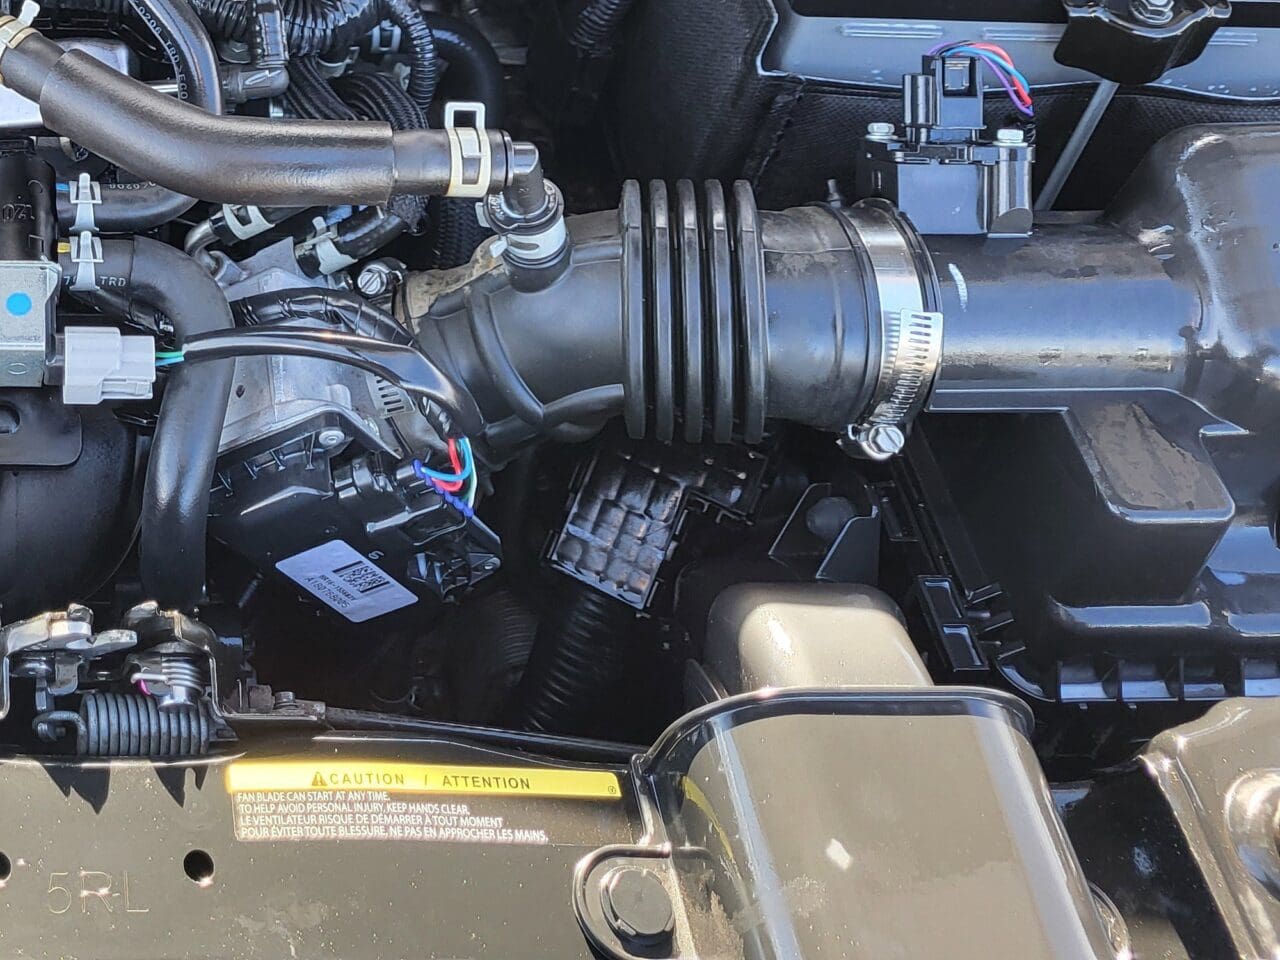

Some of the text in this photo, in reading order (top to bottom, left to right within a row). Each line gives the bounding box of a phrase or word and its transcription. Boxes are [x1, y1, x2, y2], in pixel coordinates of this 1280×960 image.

[99, 276, 127, 287] TRD
[329, 773, 404, 785] CAUTION
[442, 775, 530, 790] ATTENTION
[237, 792, 254, 802] FAN
[257, 792, 285, 801] BLADE
[286, 792, 306, 801] CAN
[307, 792, 334, 801] START
[335, 792, 346, 801] AT
[348, 792, 365, 801] ANY
[239, 803, 252, 814] TO
[254, 803, 275, 814] HELP
[278, 803, 305, 813] AVOID
[307, 803, 352, 813] PERSONAL
[387, 803, 407, 813] KEEP
[409, 804, 439, 814] HANDS
[241, 815, 251, 826] LE
[253, 815, 316, 825] VENTILATEUR
[319, 815, 353, 825] RISQUE
[355, 815, 369, 824] DE
[371, 813, 423, 825] DÉMARRER
[432, 816, 457, 826] TOUT
[461, 817, 503, 828] MOMENT
[241, 827, 269, 838] POUR
[272, 825, 303, 837] ÉVITER
[305, 826, 336, 836] TOUTE
[390, 826, 404, 836] NE
[405, 827, 423, 837] PAS
[424, 827, 437, 838] EN
[439, 828, 495, 839] APPROCHER
[497, 829, 513, 839] LES
[47, 869, 150, 914] 5RL
